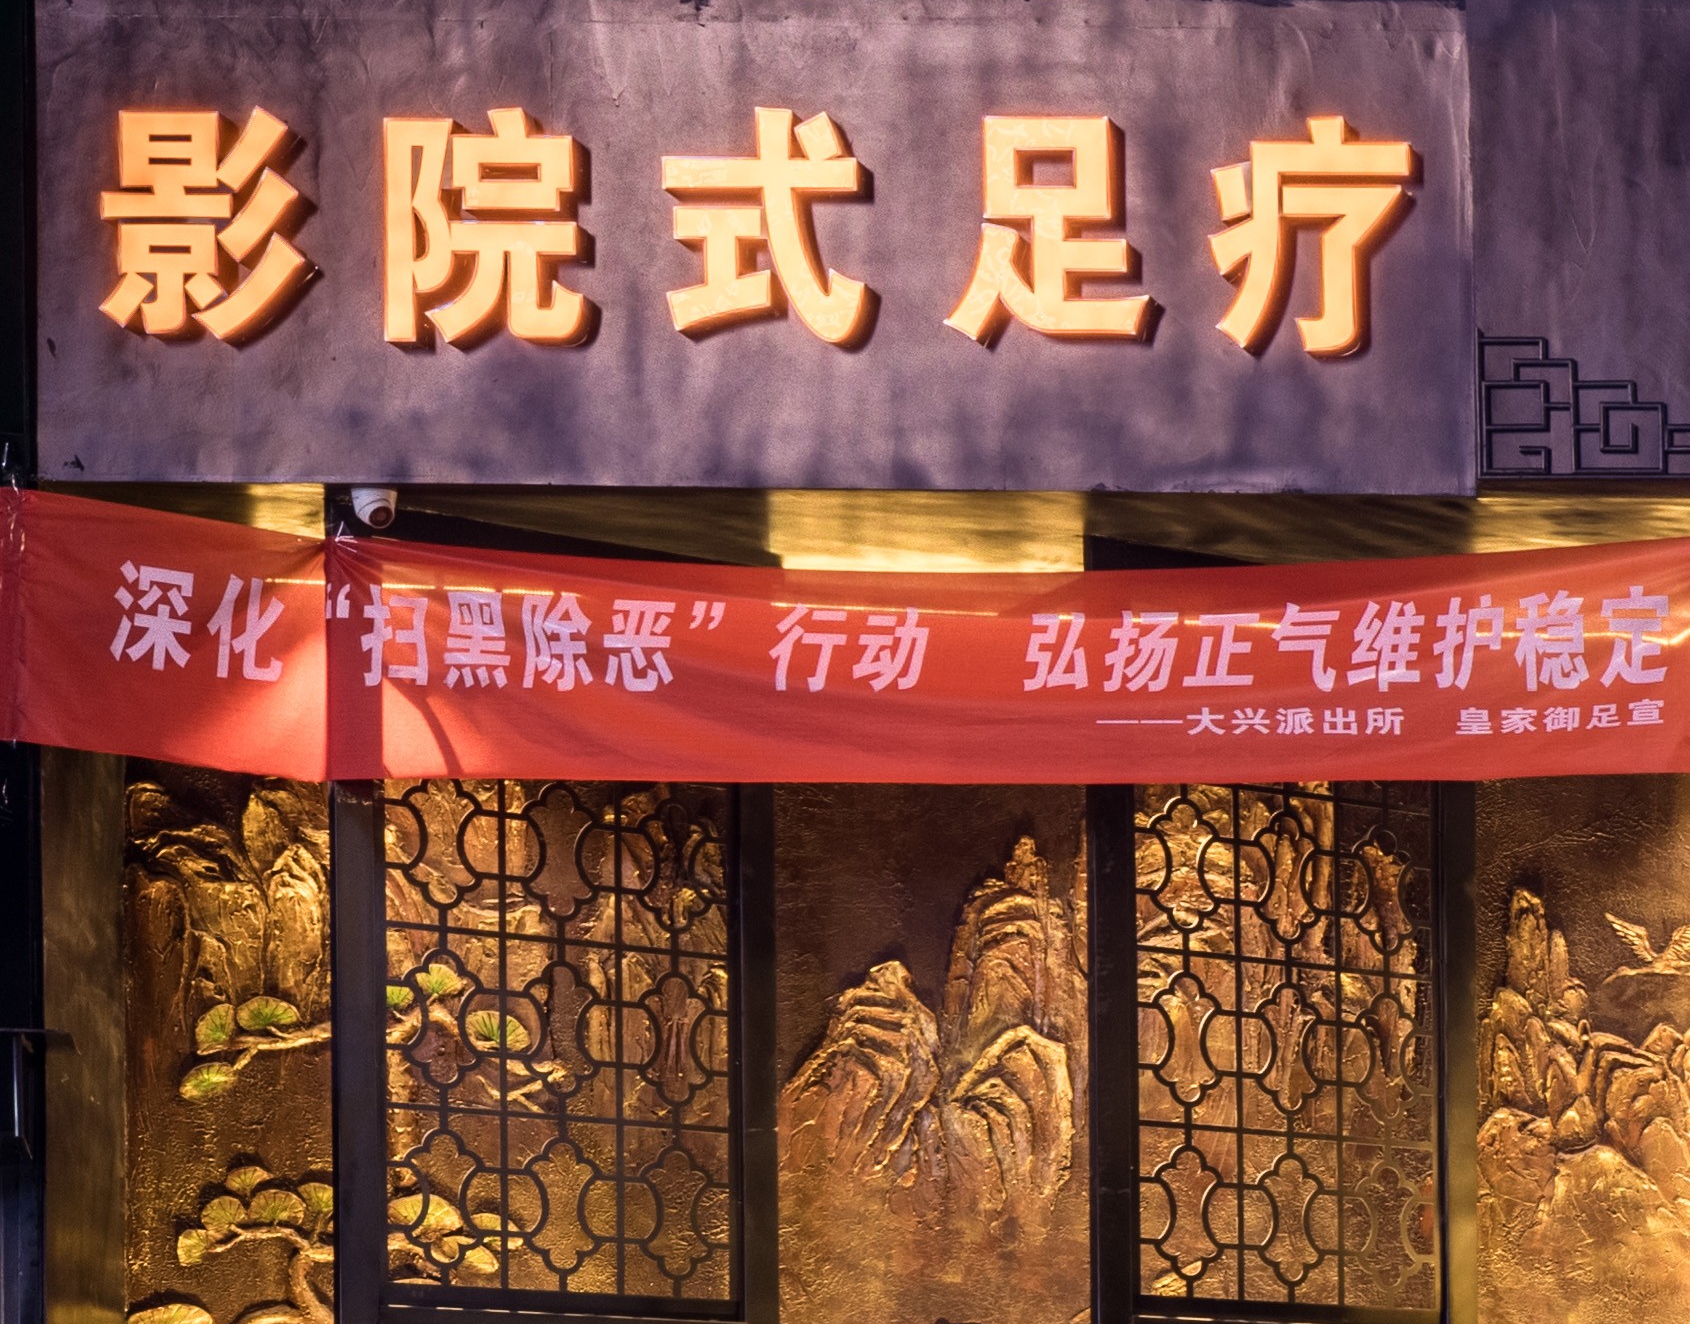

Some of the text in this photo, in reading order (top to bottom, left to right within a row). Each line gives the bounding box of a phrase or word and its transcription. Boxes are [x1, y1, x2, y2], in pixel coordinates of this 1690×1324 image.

[99, 105, 1412, 354] 影院式足疗
[1022, 585, 1670, 693] 弘扬正气维护稳定
[1455, 699, 1666, 736] 皇家御足宣
